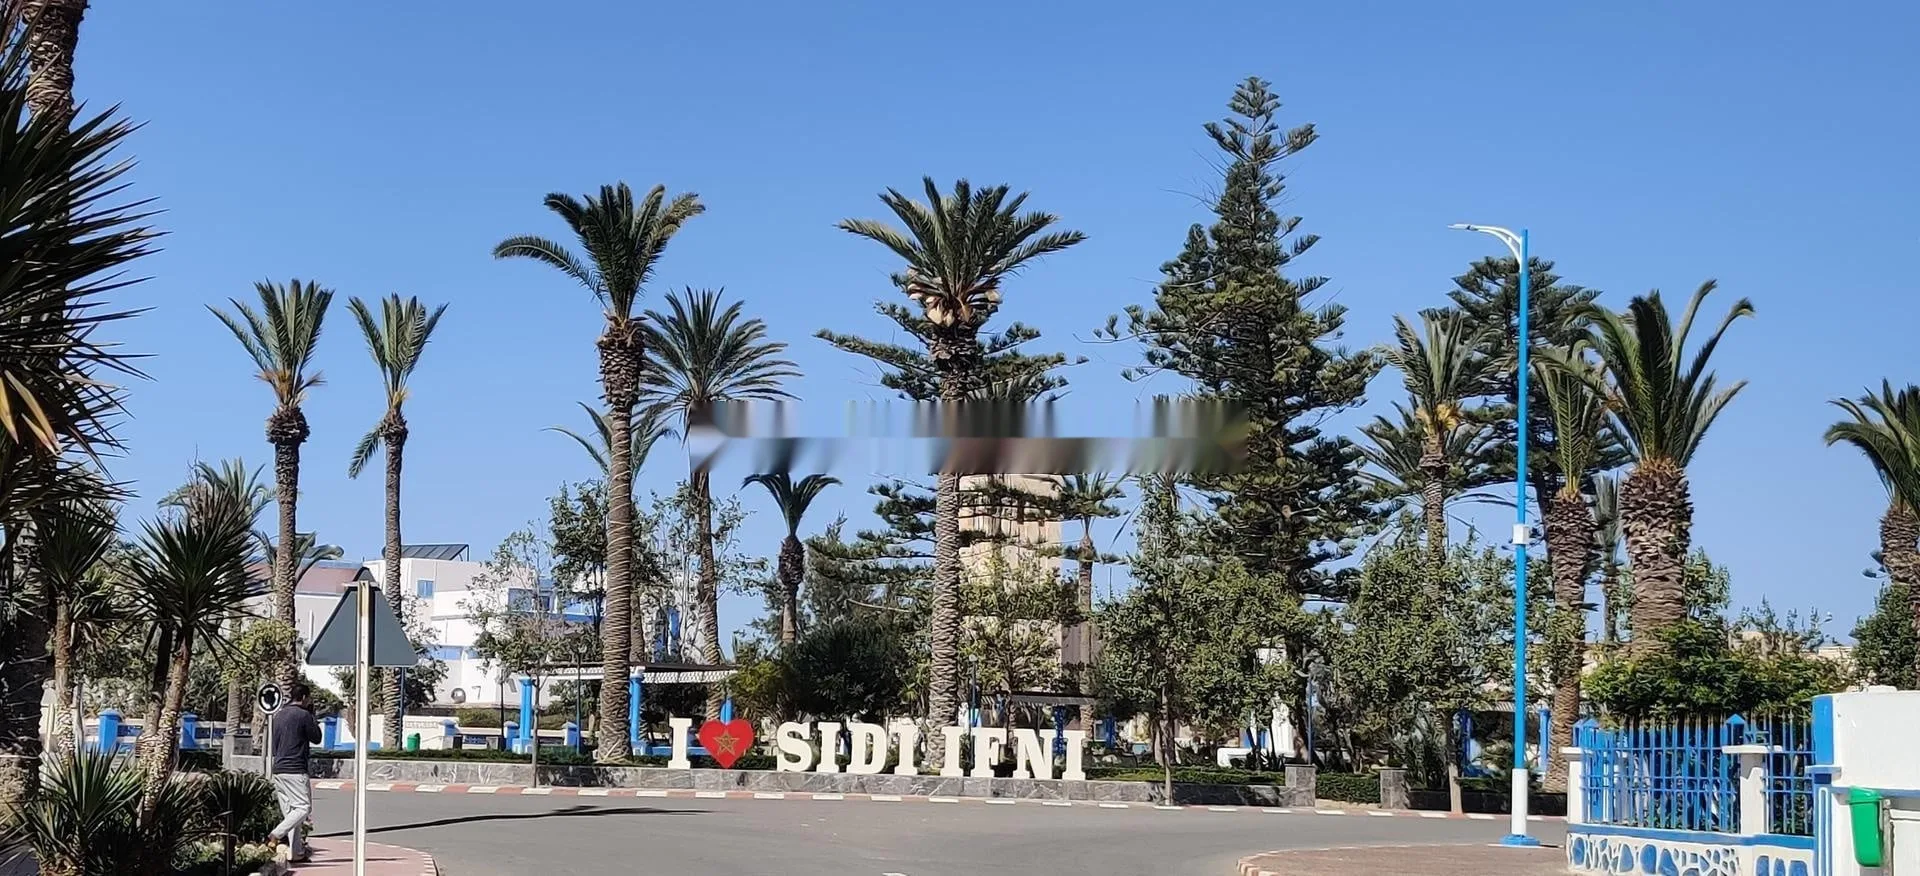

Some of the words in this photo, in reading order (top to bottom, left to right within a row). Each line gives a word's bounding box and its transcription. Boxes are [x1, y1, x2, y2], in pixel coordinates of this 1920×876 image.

[668, 718, 692, 769] I
[776, 721, 918, 775] SIDI
[940, 726, 1086, 780] IFNI
